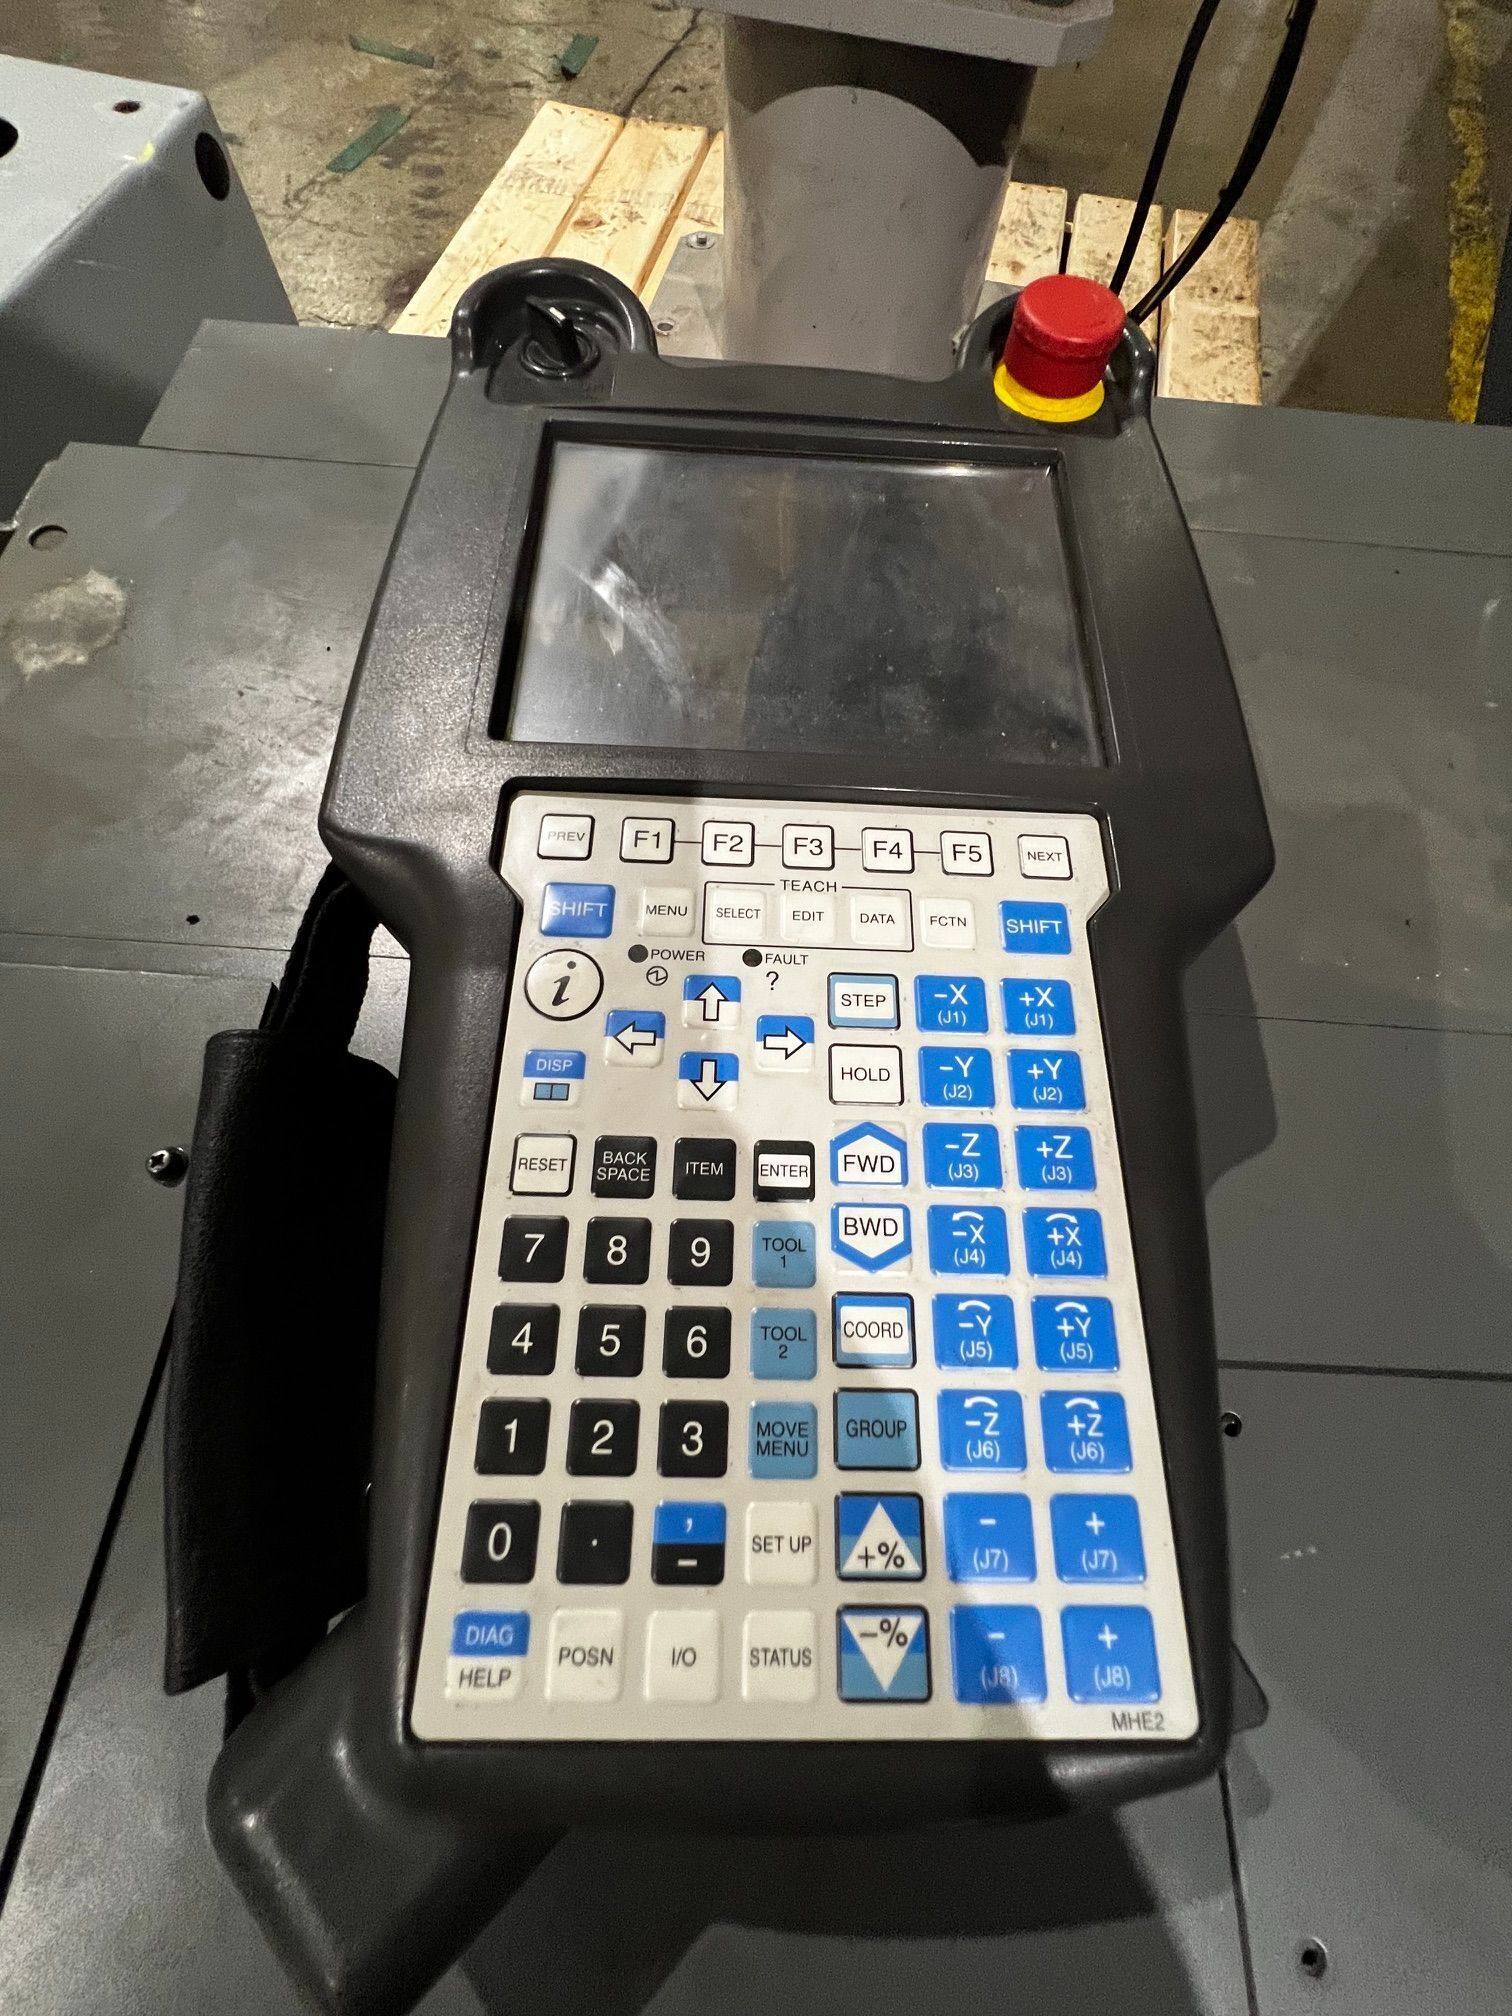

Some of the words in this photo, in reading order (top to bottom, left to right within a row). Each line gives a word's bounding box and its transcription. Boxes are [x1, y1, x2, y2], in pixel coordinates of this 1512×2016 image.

[547, 831, 586, 842] PREV
[633, 830, 661, 849] F1
[713, 834, 743, 853] F2
[794, 838, 823, 856] F3
[873, 841, 903, 859] F4
[952, 844, 982, 862] F5
[1027, 851, 1062, 862] NEXT
[780, 880, 837, 892] TEACH
[550, 901, 608, 918] SHIFT
[646, 905, 688, 916] MENU
[716, 908, 761, 919] SELECT
[792, 910, 825, 922] EDIT
[860, 913, 895, 925] DATA
[930, 916, 967, 927] FCTN
[1006, 919, 1063, 935] SHIFT
[650, 949, 705, 962] POWER
[765, 953, 808, 965] FAULT
[841, 994, 886, 1008] STEP
[934, 983, 969, 1005] -X
[1019, 986, 1054, 1008] +X
[938, 1011, 967, 1026] (J1)
[1025, 1014, 1054, 1029] (J1)
[536, 1059, 573, 1071] DISP
[939, 1056, 974, 1077] -Y
[1027, 1058, 1063, 1080] +Y
[840, 1067, 890, 1082] HOLD
[943, 1084, 973, 1101] (J2)
[1033, 1086, 1063, 1103] (J2)
[945, 1133, 981, 1156] -Z
[1036, 1135, 1074, 1159] +Z
[518, 1157, 568, 1172] RESET
[602, 1151, 648, 1165] BACK
[844, 1155, 895, 1173] FWD
[596, 1167, 650, 1182] SPACE
[685, 1161, 724, 1176] ITEM
[760, 1163, 809, 1178] ENTER
[948, 1163, 979, 1180] (J3)
[1041, 1166, 1072, 1183] (J3)
[844, 1218, 898, 1236] BWD
[952, 1225, 986, 1244] -X
[761, 1237, 807, 1252] TOOL
[1047, 1227, 1082, 1246] +X
[523, 1233, 545, 1263] 7
[606, 1235, 627, 1266] 8
[690, 1236, 711, 1267] 9
[779, 1255, 787, 1268] 1
[954, 1249, 986, 1266] (J4)
[1051, 1251, 1082, 1269] (J4)
[760, 1326, 807, 1342] TOOL
[844, 1322, 904, 1338] COORD
[958, 1315, 992, 1336] -Y
[1057, 1317, 1091, 1338] +Y
[511, 1322, 534, 1354] 4
[599, 1324, 621, 1357] 5
[686, 1325, 708, 1358] 6
[778, 1345, 788, 1359] 2
[960, 1342, 993, 1360] (J5)
[1060, 1344, 1093, 1362] (J5)
[756, 1422, 809, 1438] MOVE
[846, 1420, 907, 1438] GROUP
[965, 1412, 999, 1435] -Z
[1067, 1413, 1104, 1437] +Z
[504, 1419, 518, 1453] 1
[590, 1420, 614, 1455] 2
[681, 1421, 704, 1456] 3
[756, 1441, 810, 1457] MENU
[966, 1441, 1000, 1462] (J6)
[1070, 1441, 1105, 1463] (J6)
[1085, 1512, 1105, 1535] +
[488, 1522, 512, 1562] 0
[752, 1536, 783, 1553] SET
[789, 1536, 812, 1553] UP
[858, 1541, 905, 1570] +%
[973, 1549, 1009, 1573] (J7)
[1082, 1550, 1117, 1573] (J7)
[466, 1625, 514, 1646] DIAG
[859, 1617, 908, 1648] -%
[1098, 1623, 1118, 1649] +
[558, 1647, 614, 1667] POSN
[671, 1648, 697, 1667] I/O
[750, 1648, 812, 1667] STATUS
[458, 1668, 511, 1689] HELP
[981, 1665, 1018, 1690] (J8)
[1094, 1665, 1130, 1690] (J8)
[1111, 1712, 1166, 1732] MHE2
